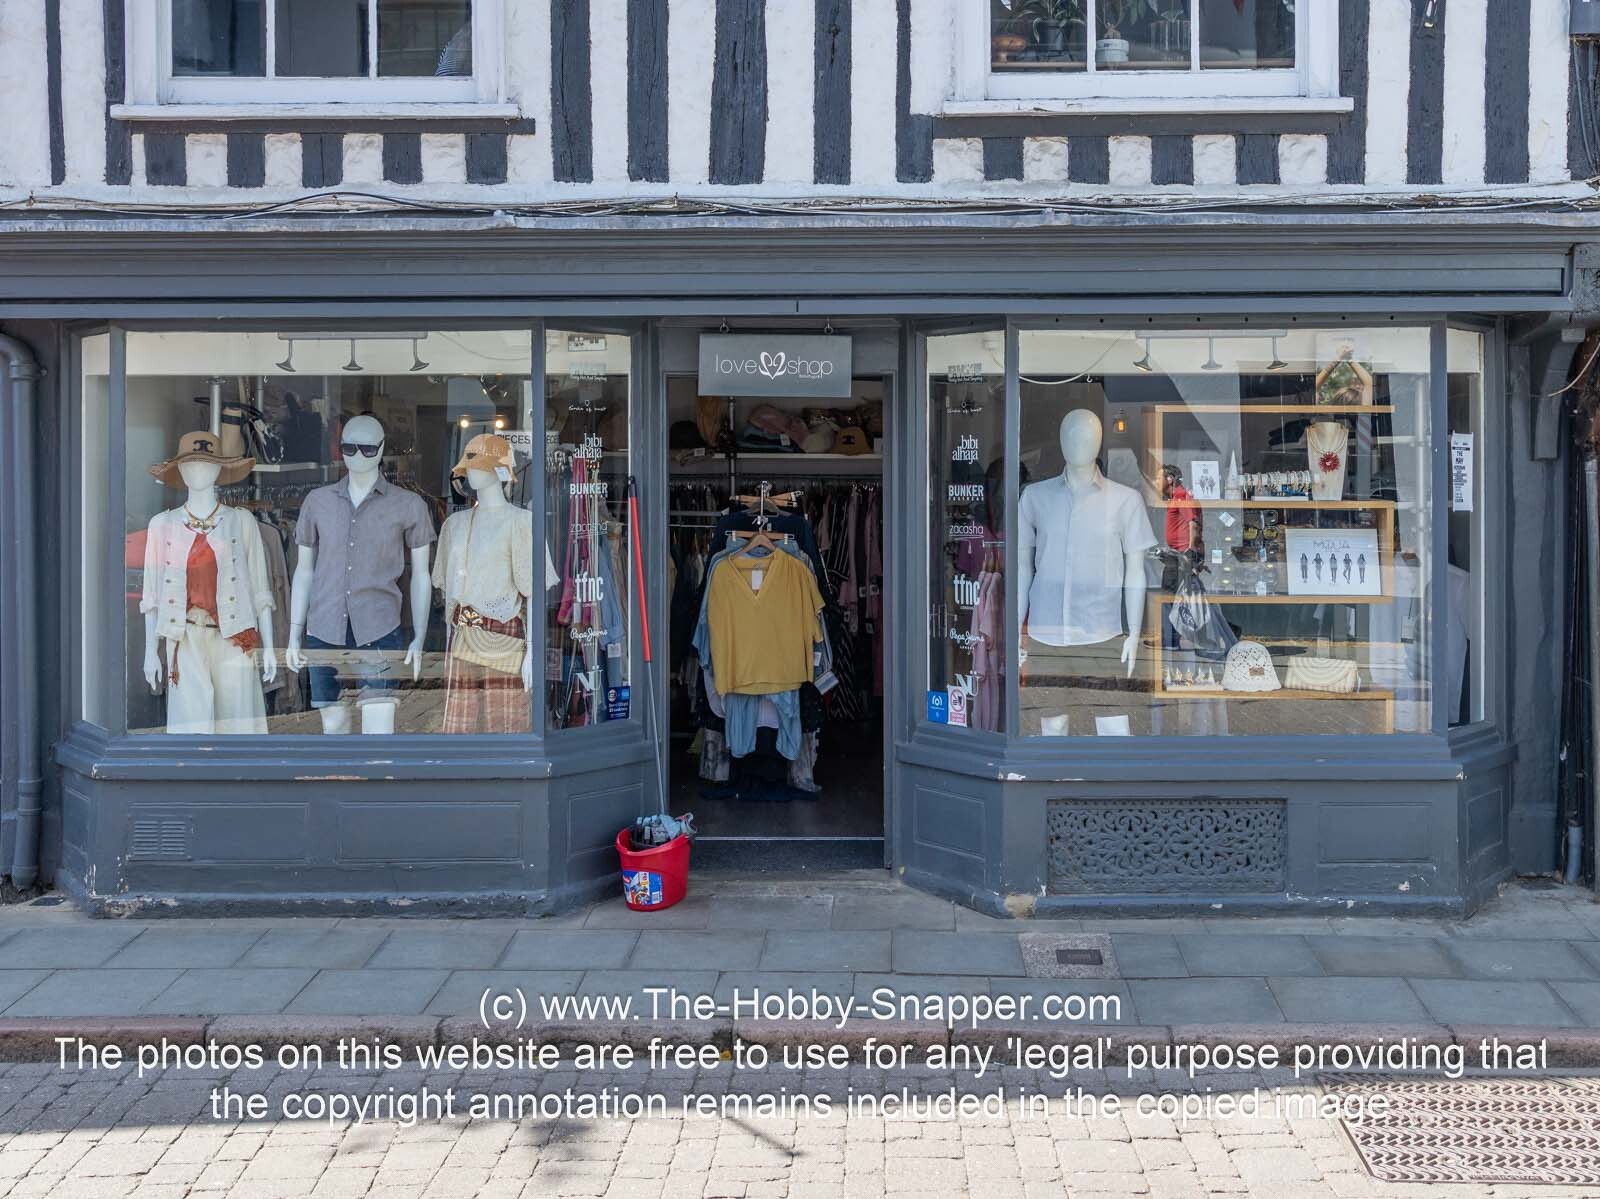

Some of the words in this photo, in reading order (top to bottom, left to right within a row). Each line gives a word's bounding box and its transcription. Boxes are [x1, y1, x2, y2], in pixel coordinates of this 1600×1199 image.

[715, 354, 758, 374] love
[787, 355, 833, 378] shop
[584, 433, 602, 447] bibi
[961, 434, 978, 449] bibi
[574, 443, 603, 462] alhaja
[952, 446, 979, 464] alhaja
[570, 482, 608, 494] BUNKER
[948, 485, 984, 496] BUNKER
[949, 520, 984, 534] zacasha
[575, 571, 604, 602] tfnc
[953, 574, 980, 606] tfnc
